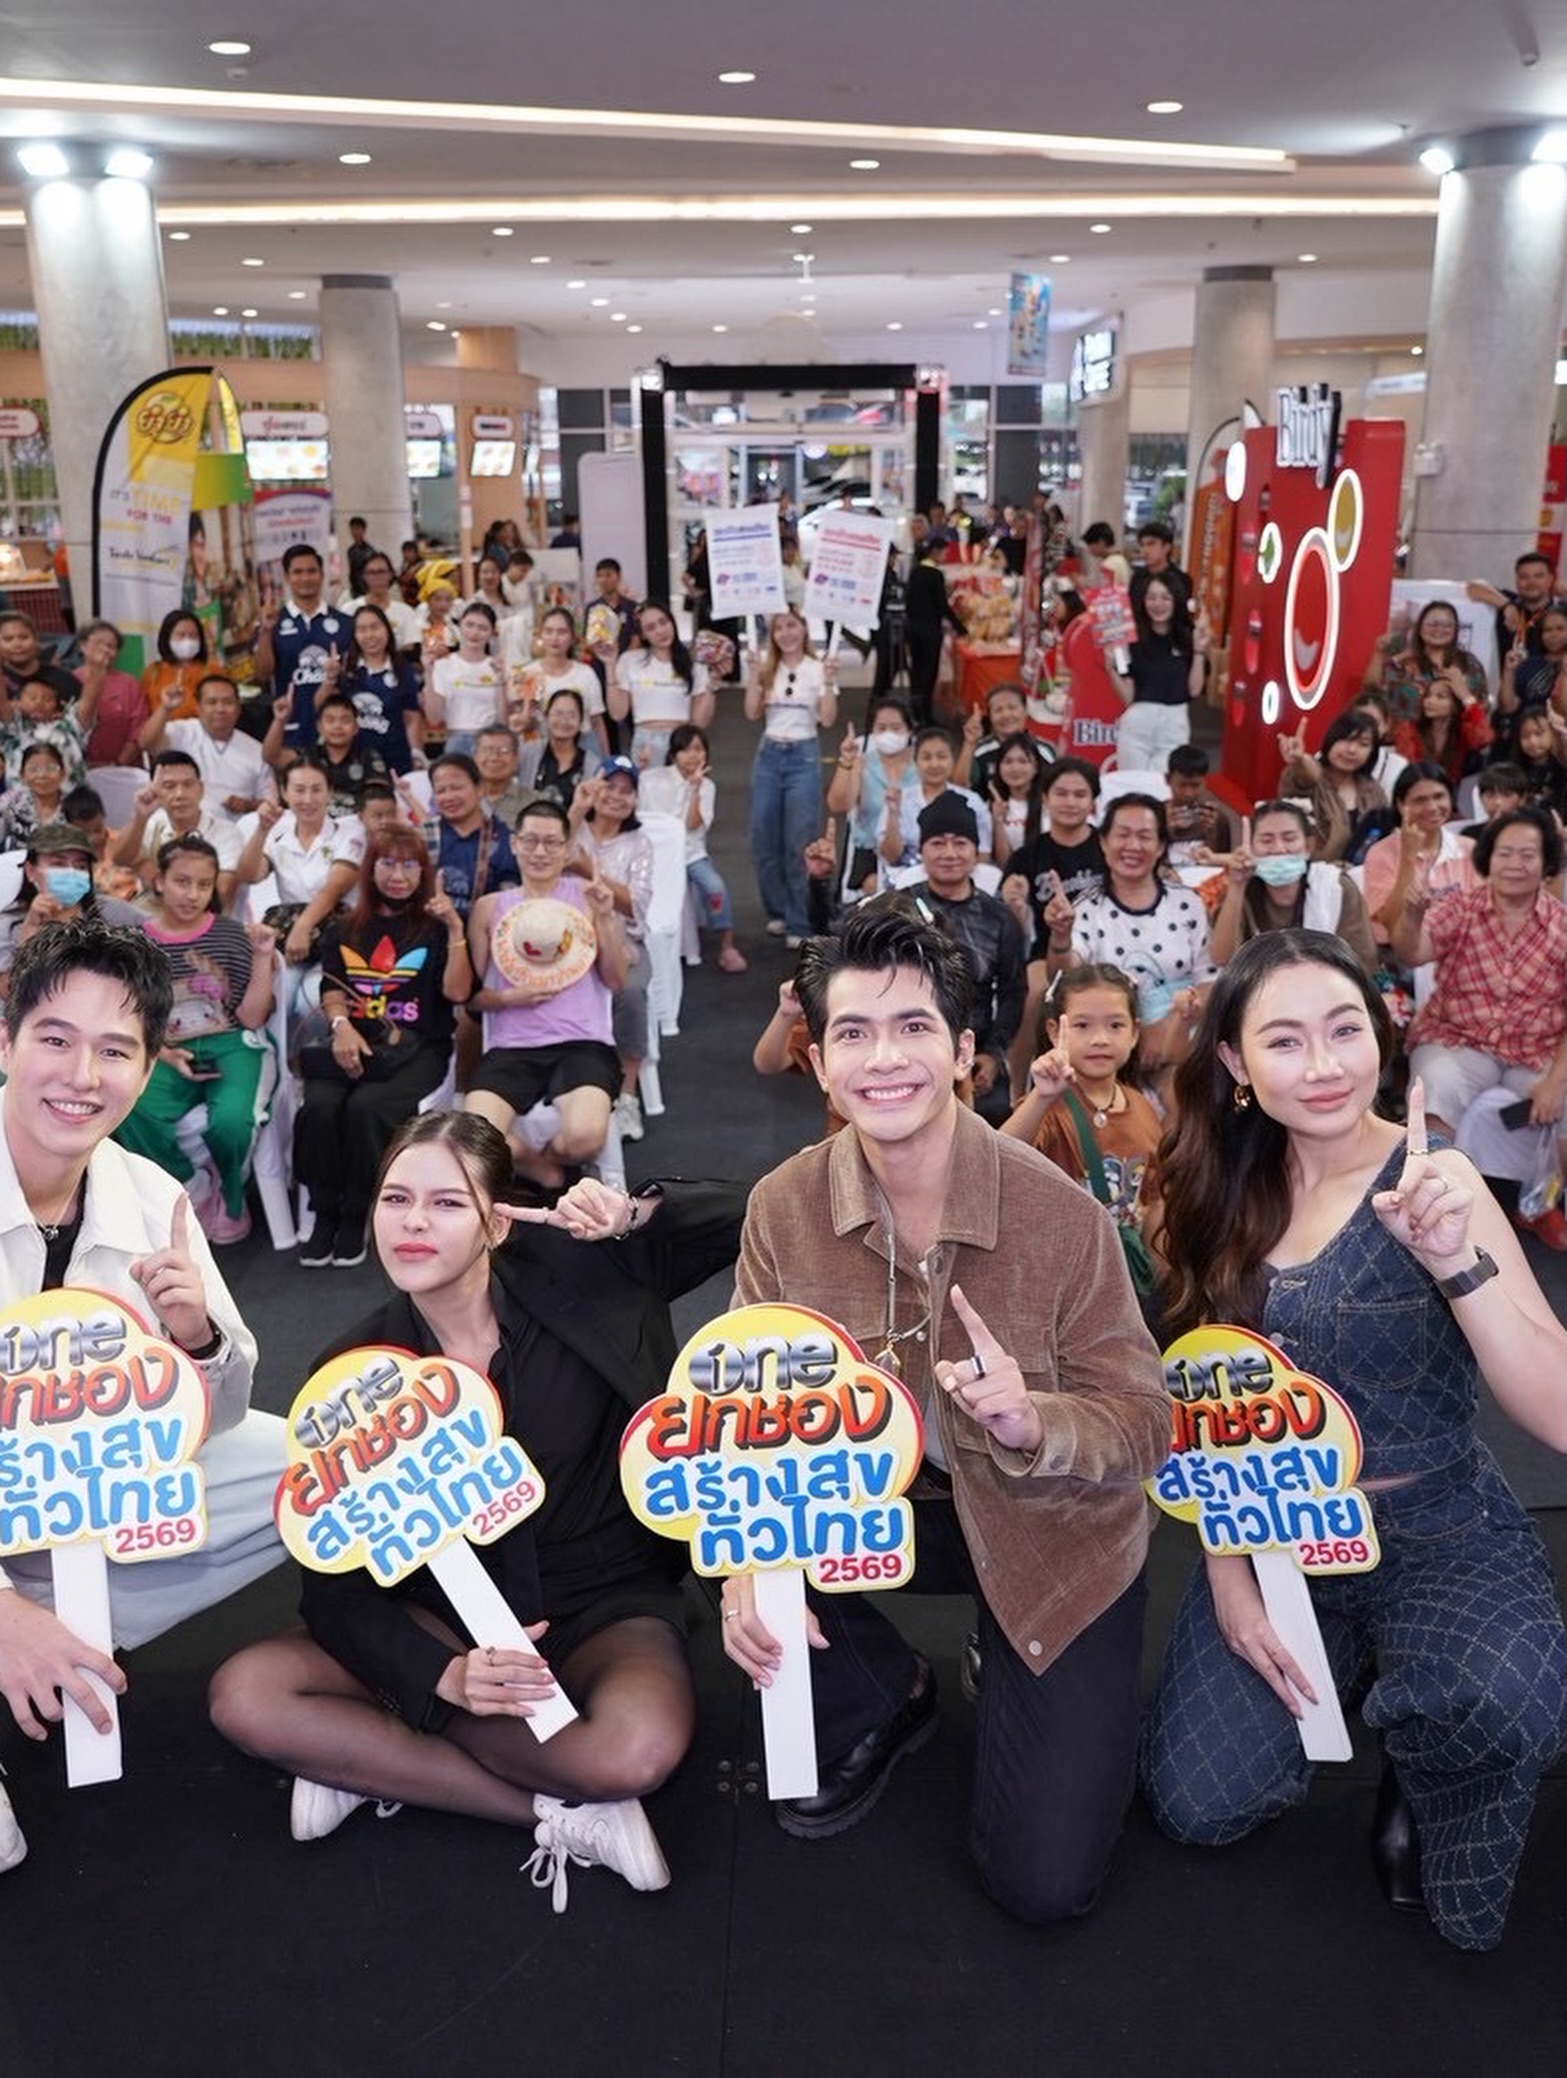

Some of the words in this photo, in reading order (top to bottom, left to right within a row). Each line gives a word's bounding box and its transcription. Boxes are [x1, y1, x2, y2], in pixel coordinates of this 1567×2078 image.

[0, 1346, 180, 1431] กช่อง
[688, 1335, 837, 1396] one
[1166, 1350, 1273, 1401] one
[294, 1357, 404, 1448] one
[0, 1418, 182, 1487] ร้างสุข
[645, 1450, 893, 1515] สร้างสุข
[1155, 1447, 1338, 1501] สร้างสุข
[307, 1410, 487, 1560] สร้างสุข
[368, 1445, 523, 1576] ทั่วไทย
[472, 1480, 536, 1537] 2569
[115, 1518, 196, 1553] 2569
[701, 1494, 903, 1566] ทั่วไทย
[1204, 1487, 1362, 1546] ทั่วไทย
[819, 1554, 903, 1583] 2569
[1299, 1540, 1368, 1566] 2569
